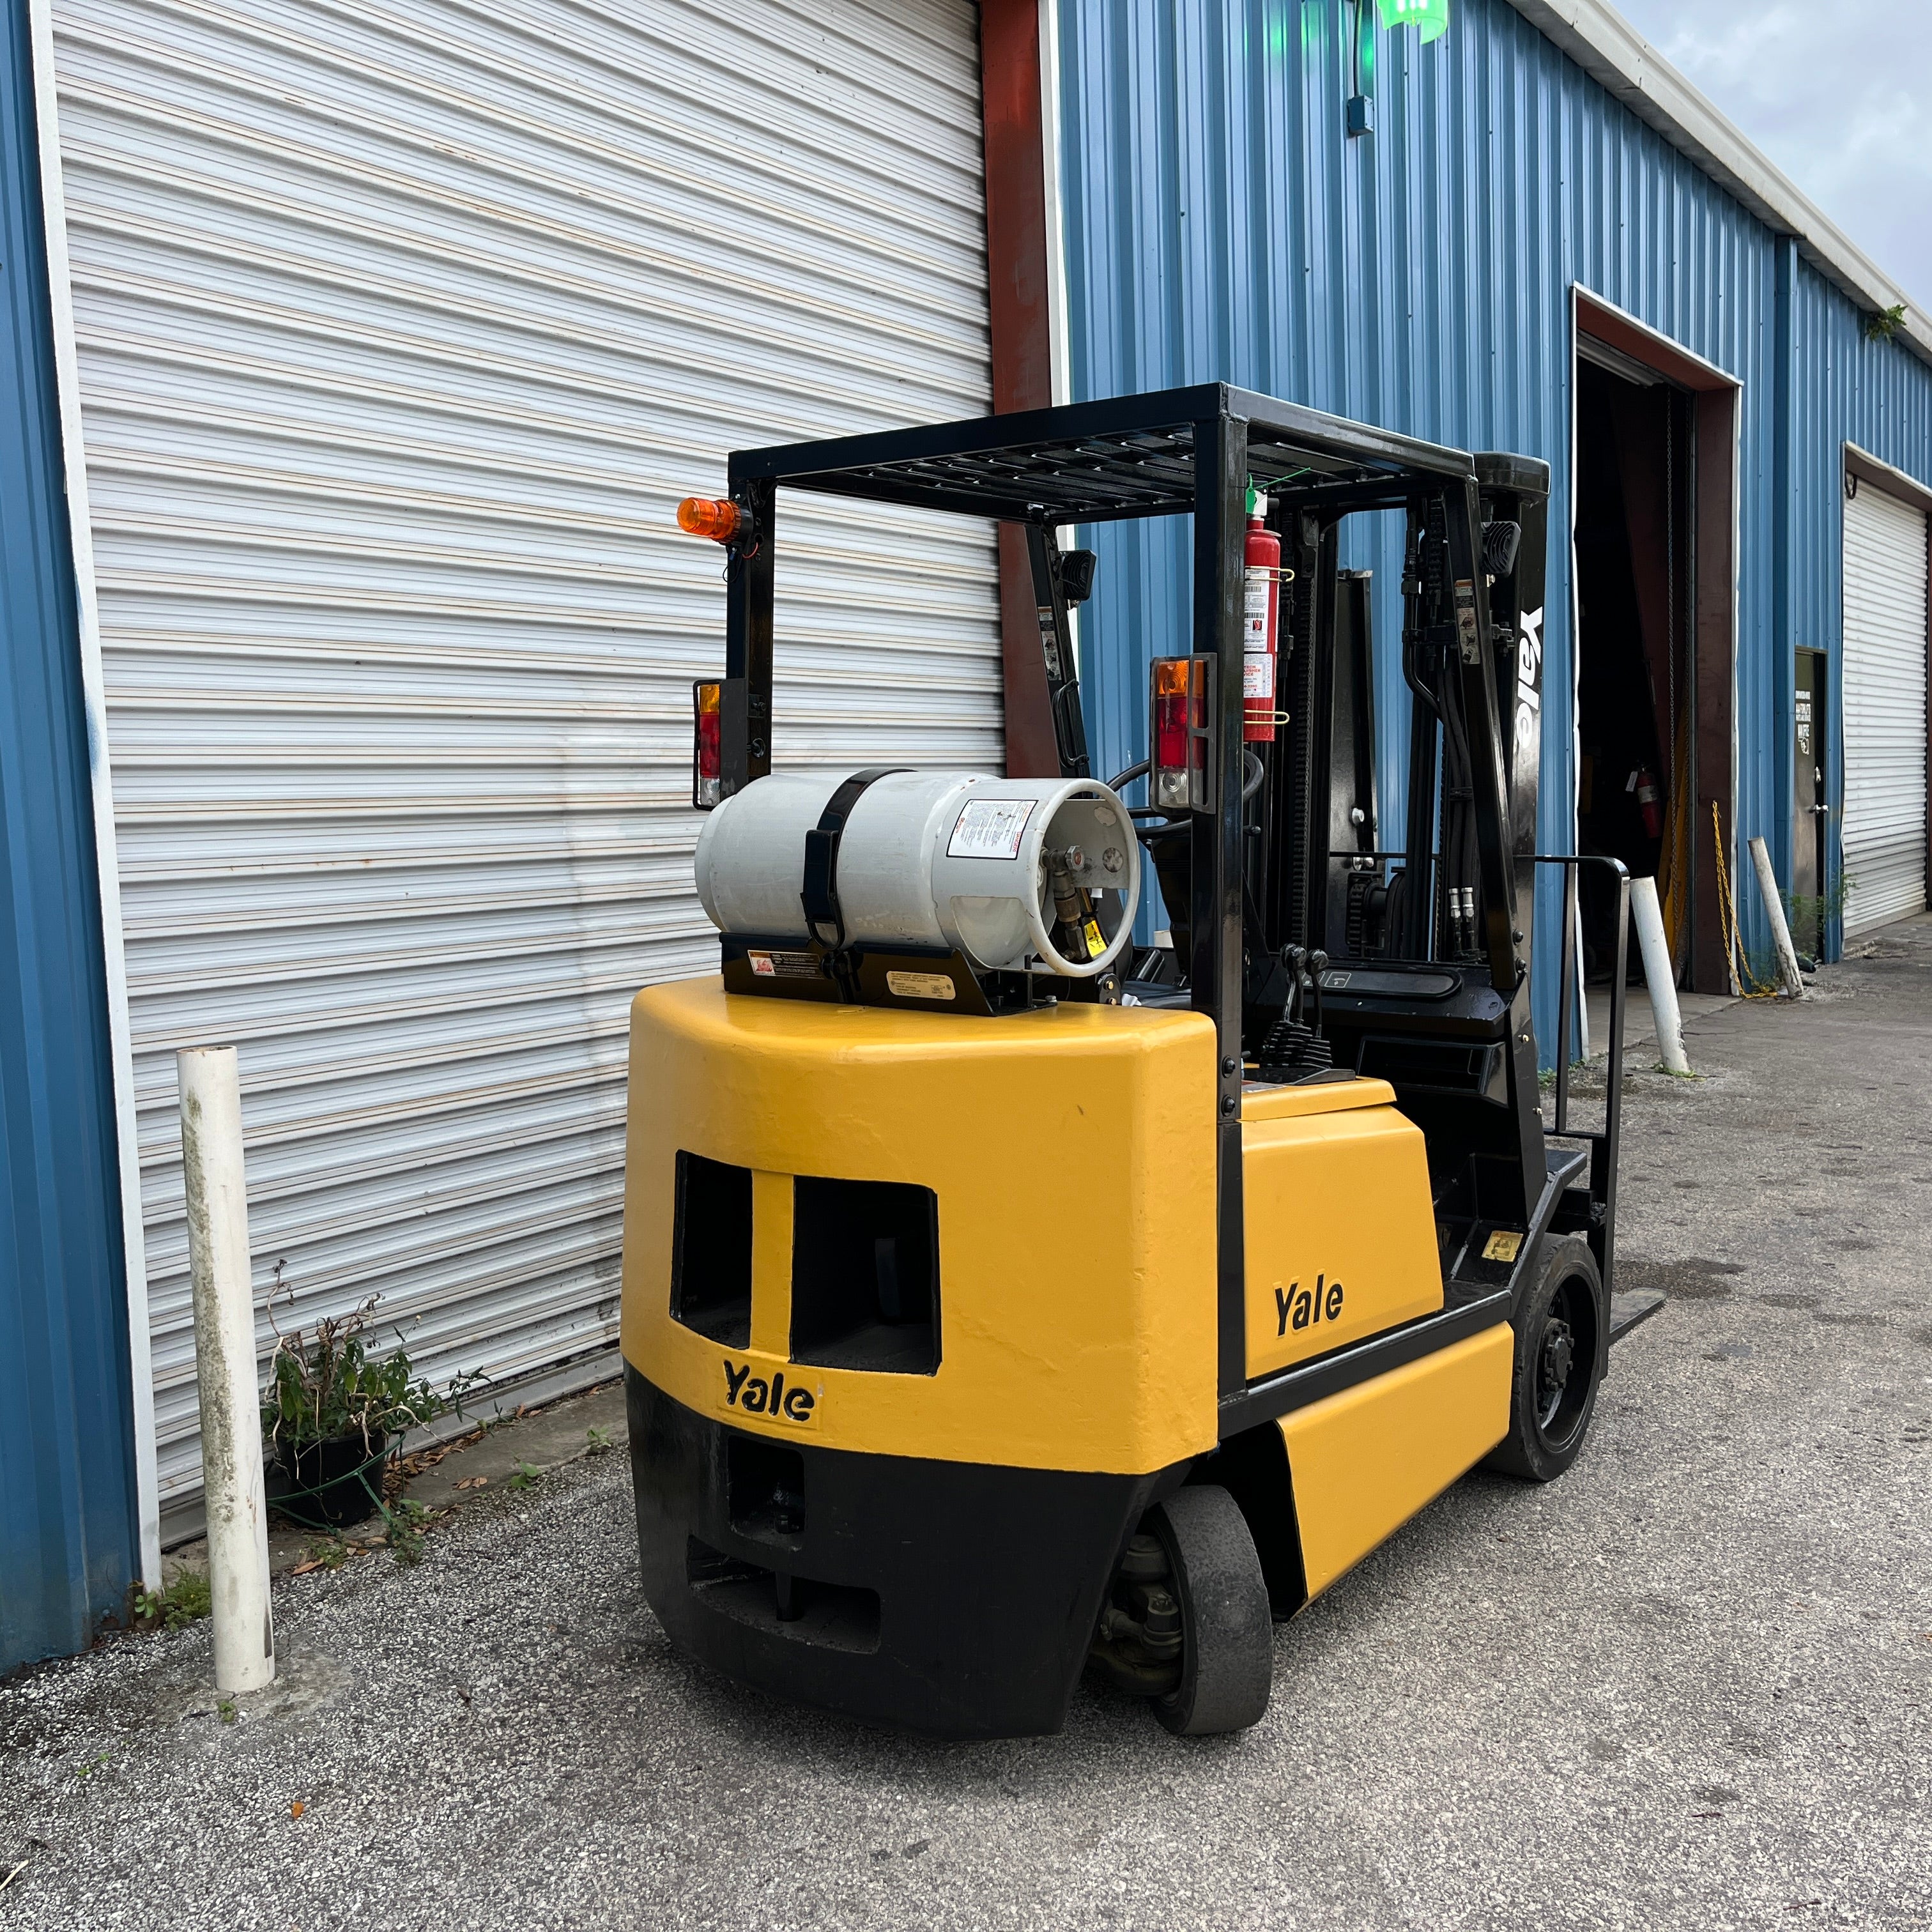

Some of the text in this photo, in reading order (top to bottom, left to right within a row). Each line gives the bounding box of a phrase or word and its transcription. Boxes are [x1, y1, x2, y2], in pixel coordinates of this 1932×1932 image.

[1516, 606, 1542, 749] Yale
[1275, 1273, 1344, 1337] Yale
[723, 1360, 815, 1422] Yale
